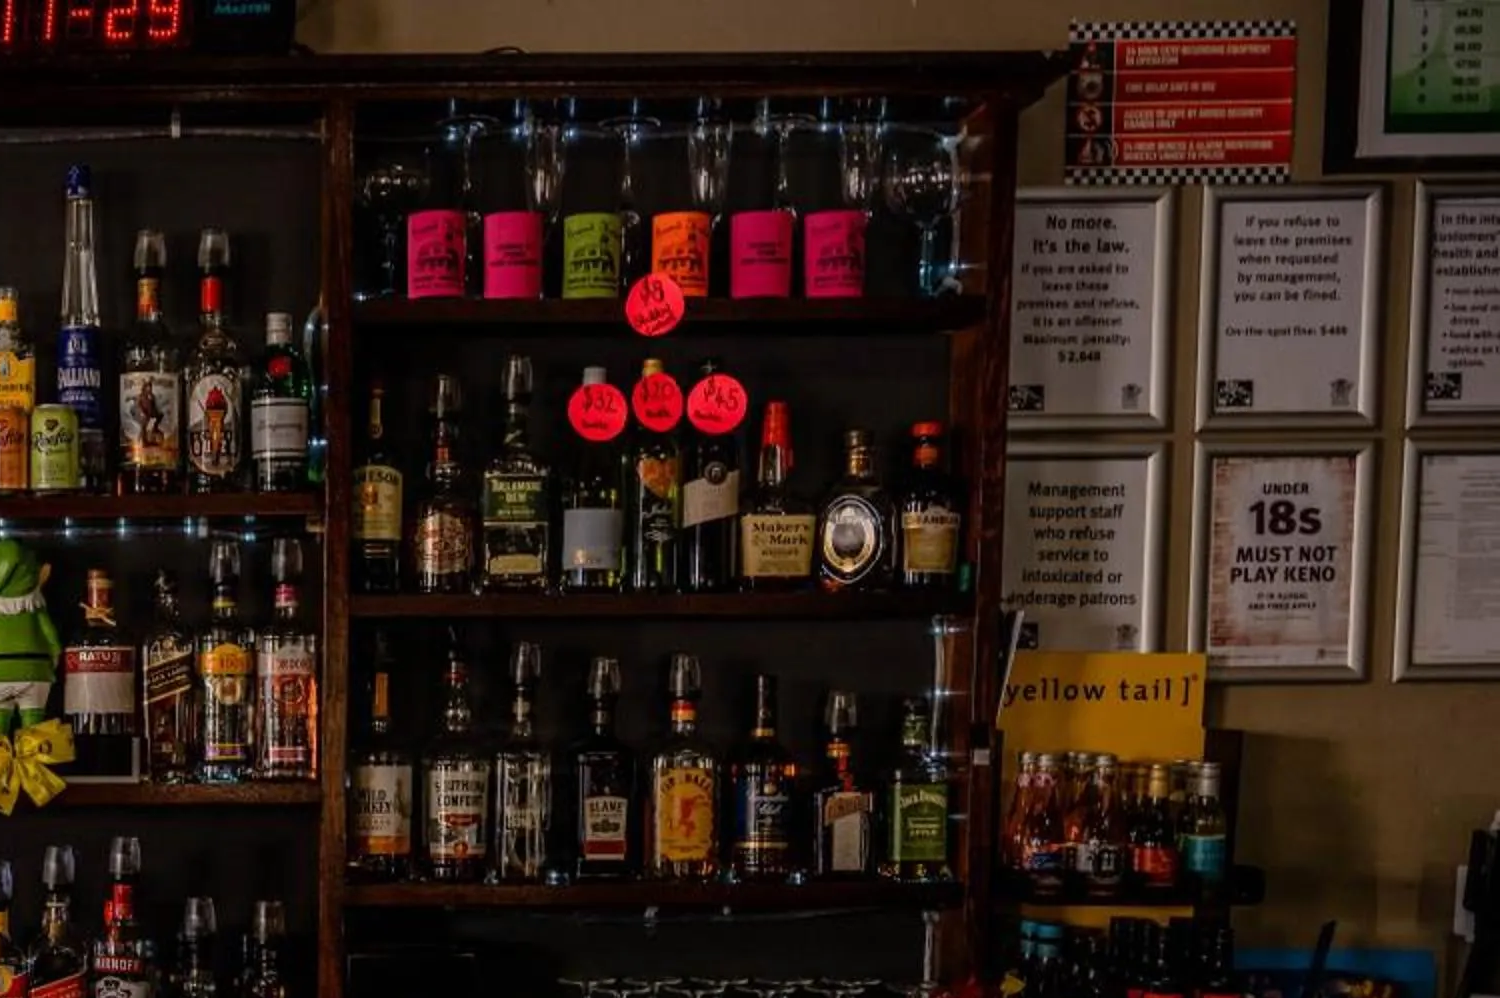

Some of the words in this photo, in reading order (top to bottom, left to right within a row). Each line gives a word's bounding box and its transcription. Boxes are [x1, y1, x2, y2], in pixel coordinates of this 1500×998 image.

[1046, 215, 1067, 230] No
[1071, 217, 1117, 230] more.
[1246, 215, 1255, 227] If
[1257, 217, 1279, 229] you
[1283, 215, 1321, 227] refuse
[1326, 215, 1340, 227] to
[1441, 214, 1453, 225] In
[1456, 214, 1475, 225] the
[1033, 238, 1057, 254] It's
[1065, 238, 1091, 253] the
[1097, 238, 1130, 254] law.
[1234, 235, 1266, 246] leave
[1270, 235, 1290, 246] the
[1295, 235, 1352, 248] premises
[1238, 253, 1271, 265] when
[1275, 253, 1339, 266] requested
[1432, 247, 1473, 259] health
[1476, 247, 1498, 259] and
[1033, 265, 1053, 277] you
[1057, 265, 1075, 274] are
[1077, 263, 1112, 274] asked
[1116, 263, 1129, 274] to
[1237, 272, 1251, 284] by
[1256, 272, 1341, 284] management,
[1041, 280, 1073, 291] leave
[1075, 280, 1109, 291] these
[1234, 291, 1256, 303] you
[1259, 291, 1281, 301] can
[1285, 290, 1299, 301] be
[1303, 290, 1341, 301] fined.
[1016, 300, 1069, 311] premises
[1073, 300, 1095, 310] and
[1057, 317, 1071, 327] an
[1028, 482, 1126, 500] Management
[1263, 482, 1310, 496] UNDER
[1029, 505, 1087, 522] support
[1090, 504, 1124, 520] staff
[1249, 500, 1322, 536] 18s
[752, 521, 810, 535] Maker's
[1033, 526, 1066, 541] who
[1069, 526, 1116, 541] refuse
[768, 535, 809, 546] Mark
[1037, 549, 1090, 563] service
[1093, 549, 1109, 562] to
[1236, 546, 1294, 563] MUST
[1299, 545, 1337, 562] NOT
[1022, 569, 1103, 584] intoxicated
[1107, 571, 1123, 584] or
[1230, 567, 1279, 584] PLAY
[1283, 566, 1336, 582] KENO
[1079, 593, 1137, 607] patrons
[1003, 675, 1106, 707] yellow
